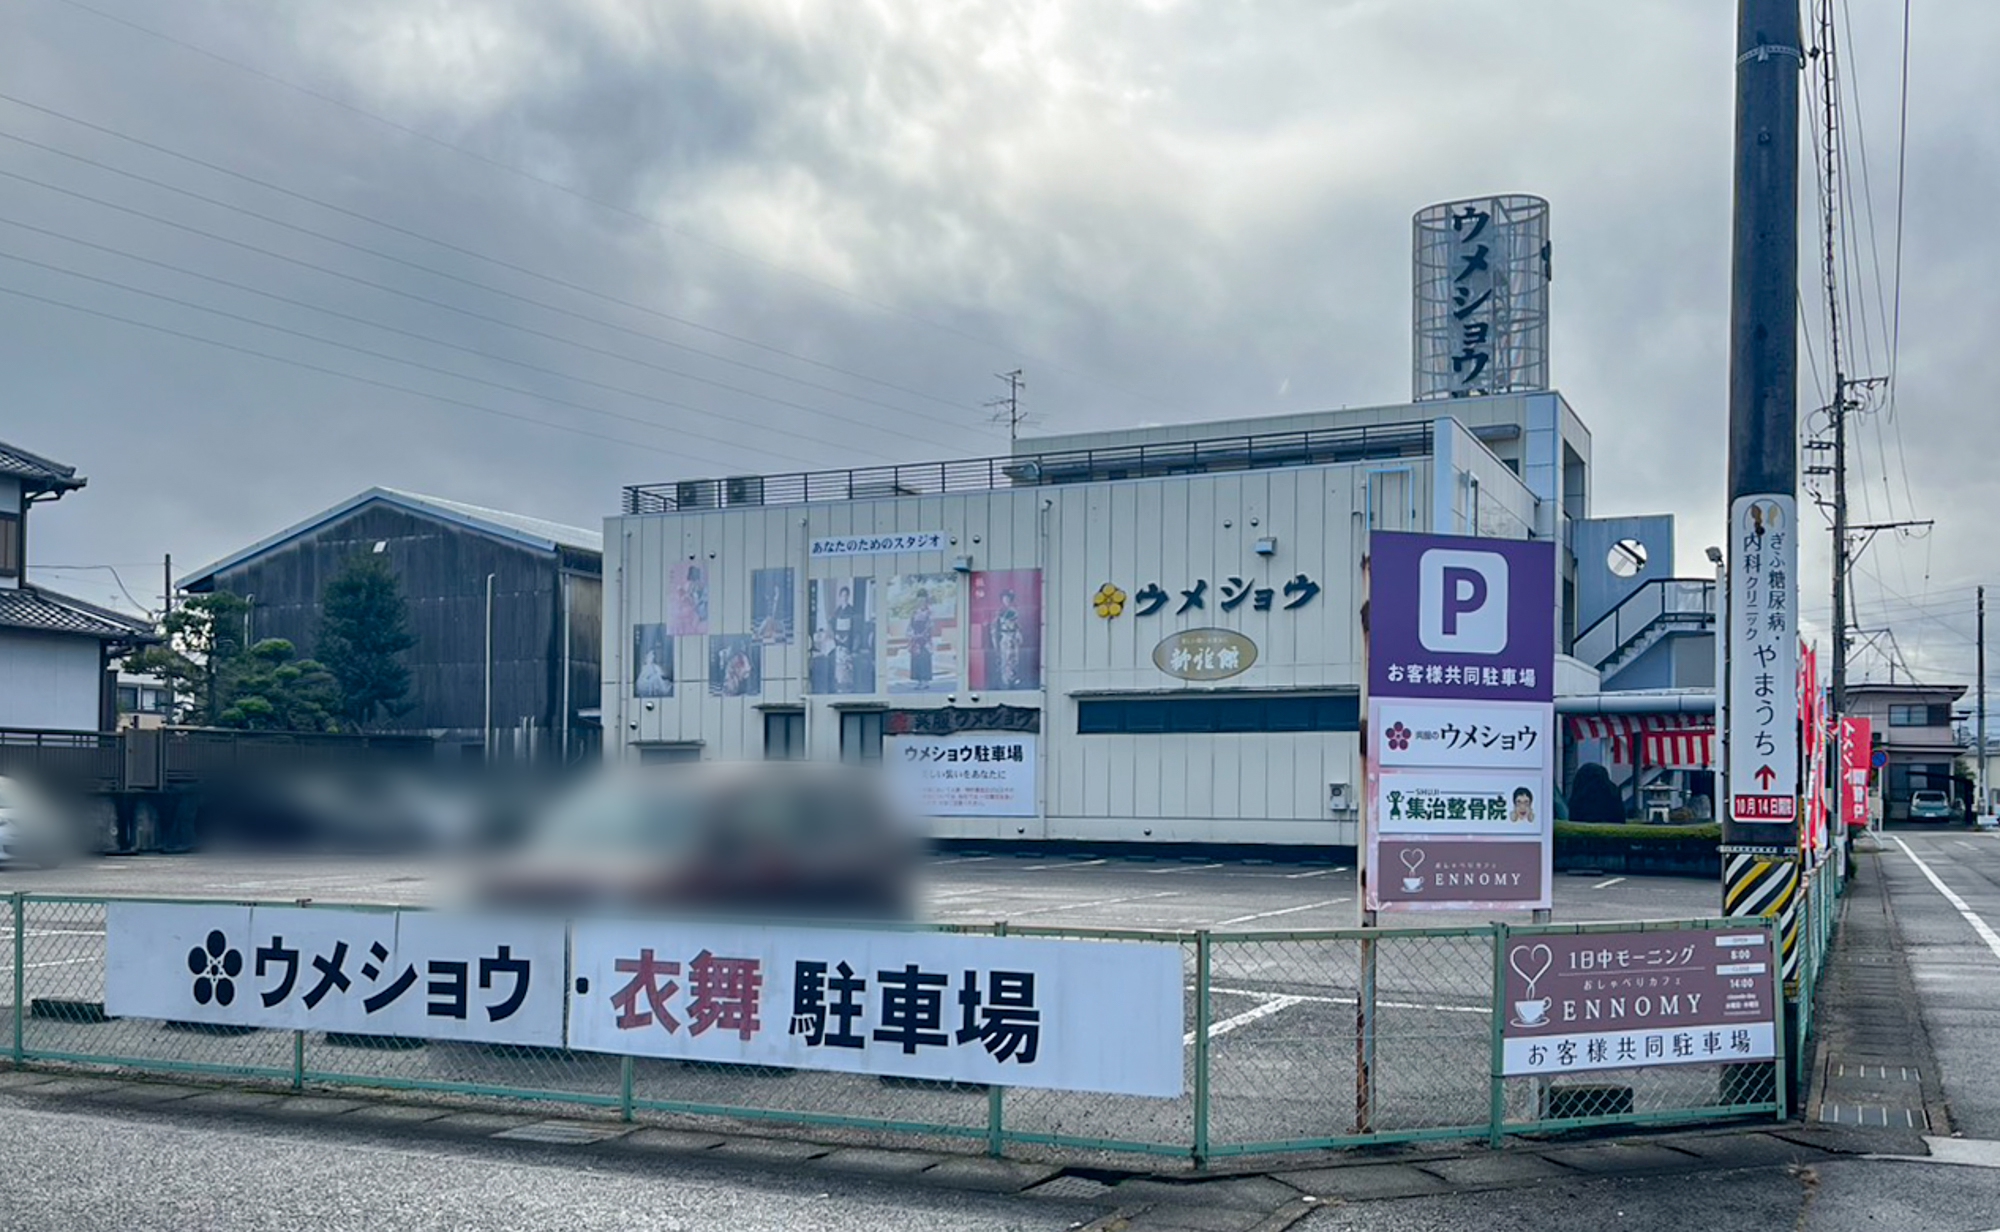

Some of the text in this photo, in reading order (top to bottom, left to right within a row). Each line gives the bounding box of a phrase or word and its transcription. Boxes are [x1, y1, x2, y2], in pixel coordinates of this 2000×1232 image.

[1453, 207, 1492, 384] ウメショウ
[812, 534, 941, 554] あなたのためのスタジオ
[1135, 574, 1321, 617] ウメショウ
[1442, 566, 1487, 635] P
[1388, 663, 1537, 688] お客様共同駐車場
[1753, 644, 1777, 756] やまうち
[905, 745, 1024, 762] ウメショウ駐車場
[1405, 796, 1507, 821] 集治整骨院
[1435, 872, 1521, 886] ENNOMY
[1569, 944, 1696, 970] 1日中モーニング
[1731, 949, 1751, 960] 8:00
[1583, 976, 1682, 991] おしゃべりカフェ
[1730, 978, 1754, 988] 14:00
[1563, 993, 1702, 1021] ENNOMY
[1528, 1029, 1752, 1067] お客様共同駐車場
